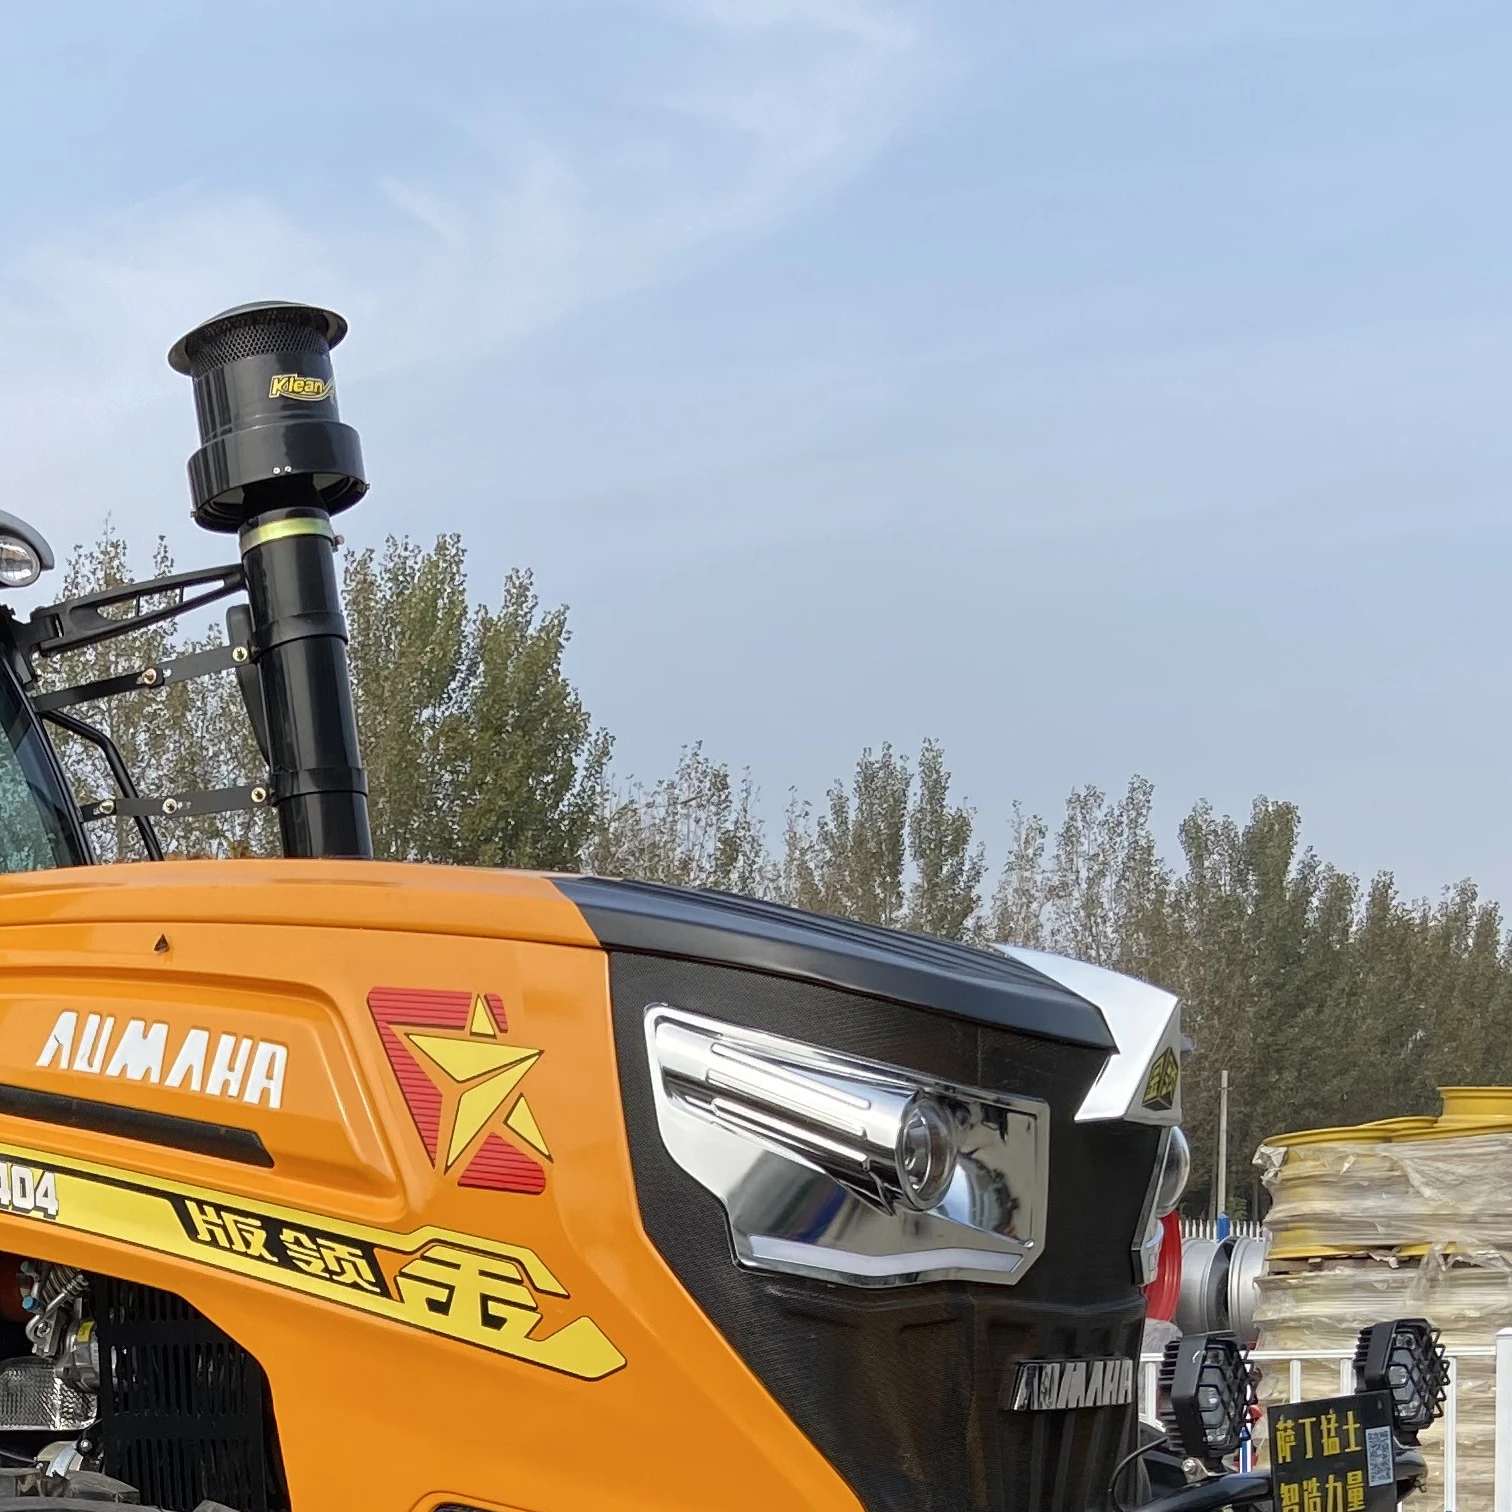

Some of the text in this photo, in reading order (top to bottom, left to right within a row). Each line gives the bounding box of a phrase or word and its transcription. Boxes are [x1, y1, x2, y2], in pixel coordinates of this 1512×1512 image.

[34, 1010, 289, 1110] AUMAHA
[1275, 1410, 1363, 1465] 萨丁猛士
